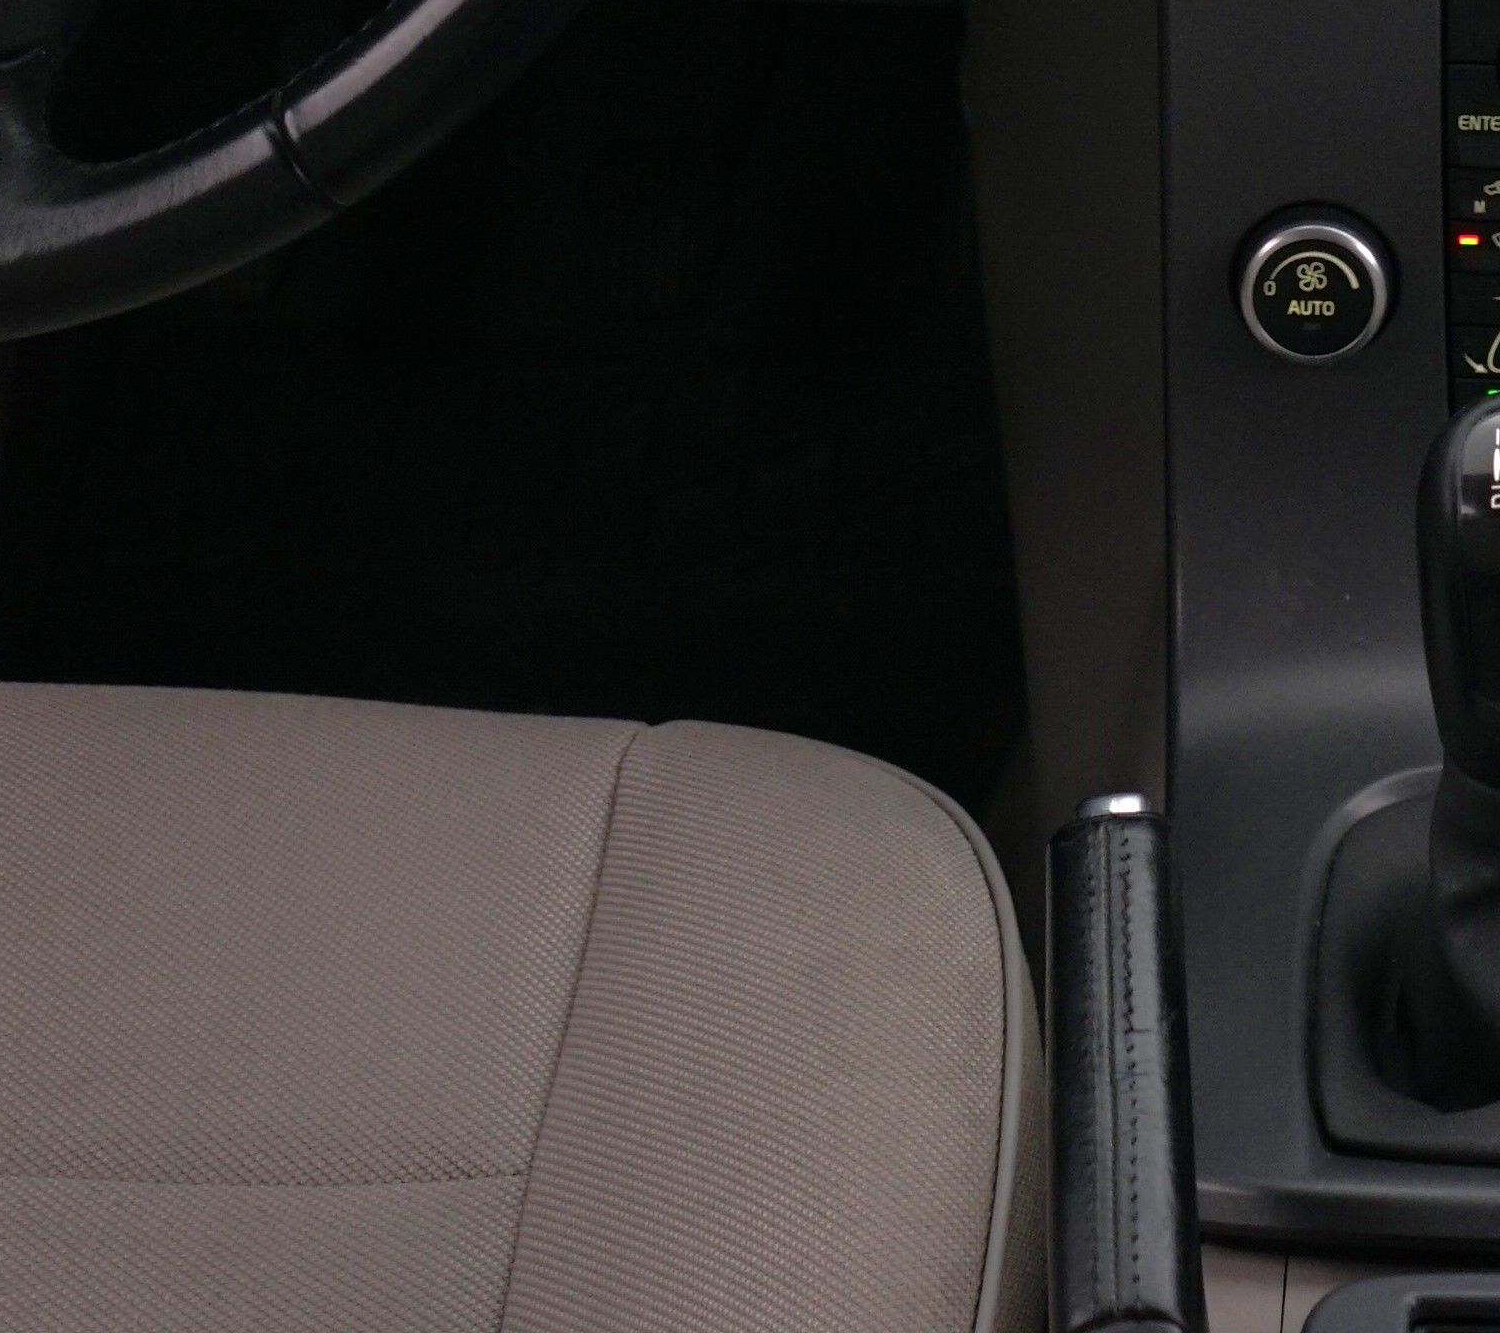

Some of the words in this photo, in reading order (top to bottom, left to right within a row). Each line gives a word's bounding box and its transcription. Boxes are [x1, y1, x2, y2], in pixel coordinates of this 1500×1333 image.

[1473, 200, 1486, 214] M
[1263, 281, 1277, 297] 0
[1287, 299, 1336, 317] AUTO
[1495, 428, 1500, 446] 1
